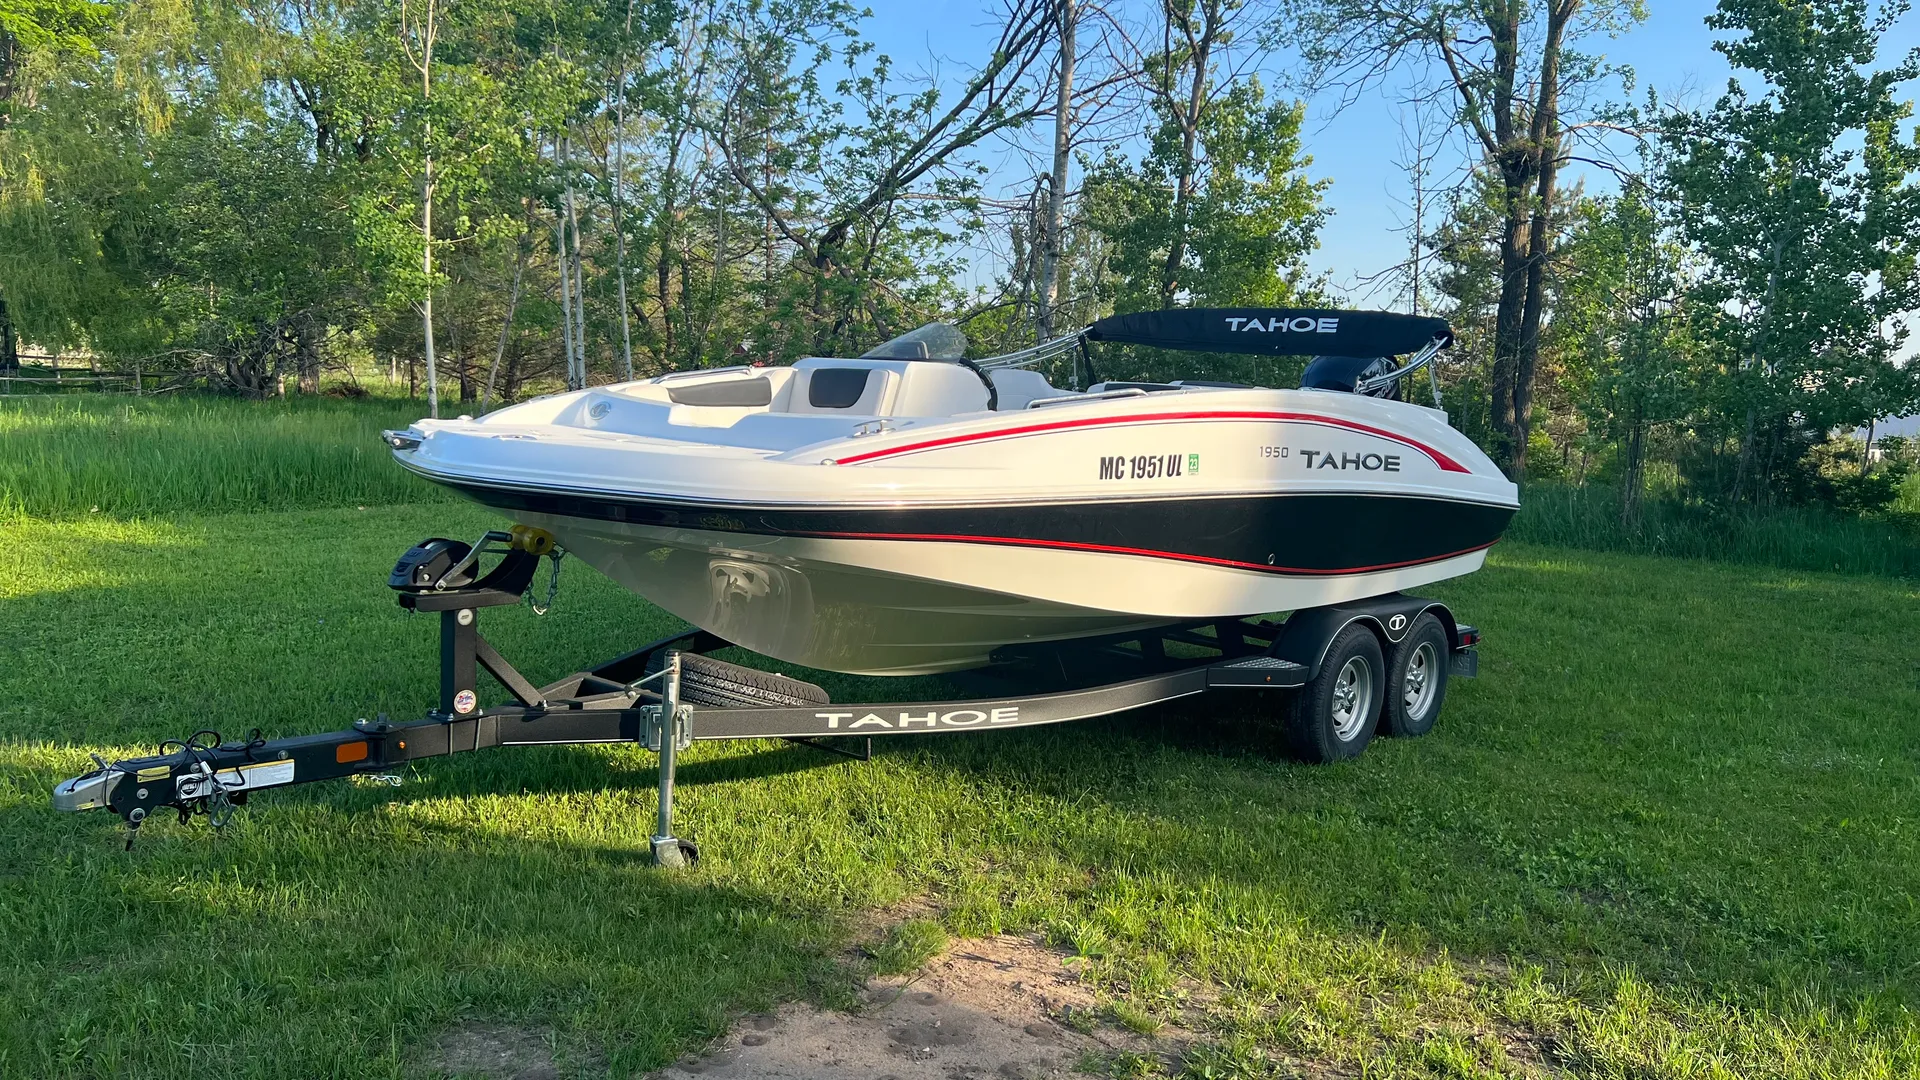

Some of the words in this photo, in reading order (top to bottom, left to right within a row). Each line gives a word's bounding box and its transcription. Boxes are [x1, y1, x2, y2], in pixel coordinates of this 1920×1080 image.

[1225, 317, 1339, 333] TAHOE
[1259, 446, 1289, 458] 1950
[1300, 449, 1400, 472] TAHOE
[1099, 455, 1126, 480] MC
[1129, 455, 1165, 479] 1951
[1166, 454, 1182, 477] UL
[1189, 458, 1198, 470] 23
[815, 707, 1019, 728] TAHOE
